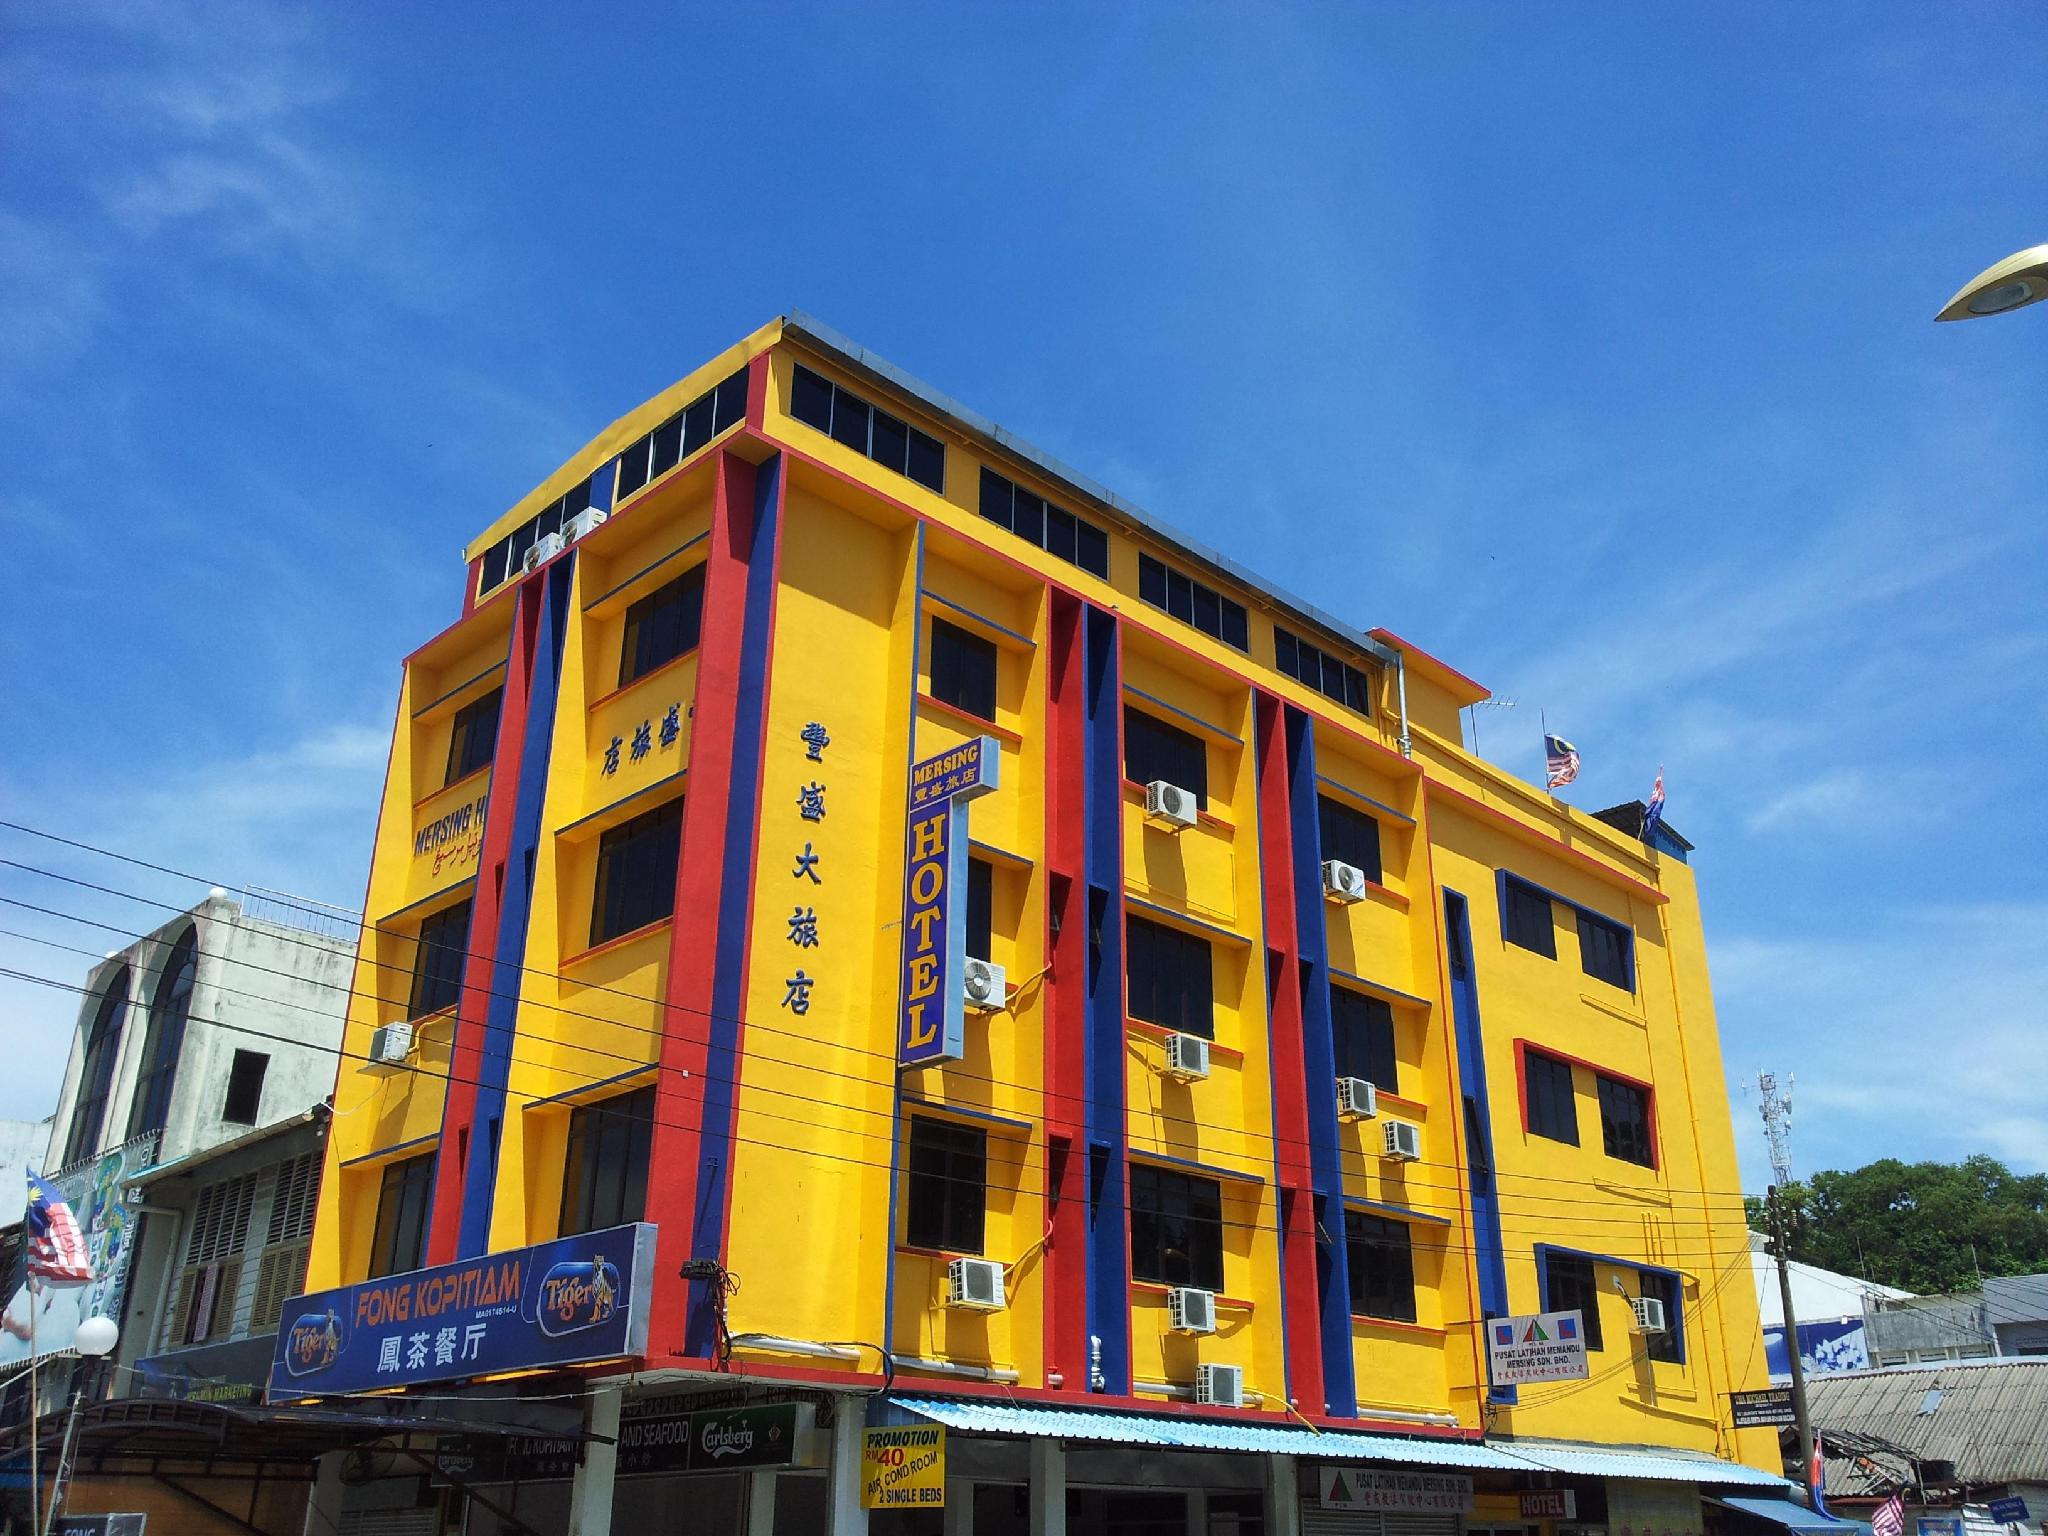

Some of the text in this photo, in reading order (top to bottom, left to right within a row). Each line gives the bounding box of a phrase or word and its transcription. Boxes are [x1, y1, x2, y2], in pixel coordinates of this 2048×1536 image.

[914, 745, 978, 787] MERSING
[414, 803, 473, 857] MERSING
[906, 813, 946, 1049] HOTEL
[355, 1260, 520, 1328] FONG KOPITIAM
[546, 1276, 594, 1321] Tiger
[293, 1327, 326, 1363] Tiger
[377, 1323, 487, 1373] 鳳茶餐厅
[1495, 1344, 1580, 1360] PUSAT LATIHAN MEMANDU
[1507, 1358, 1535, 1369] MERSING
[621, 1420, 690, 1448] AND SEAFOOD
[702, 1421, 753, 1456] Carlsberg
[867, 1430, 939, 1449] PROMOTION
[868, 1451, 938, 1496] AIR COND ROOM
[879, 1487, 942, 1503] 2 SINGLE BEDS
[1522, 1495, 1563, 1514] HOTEL
